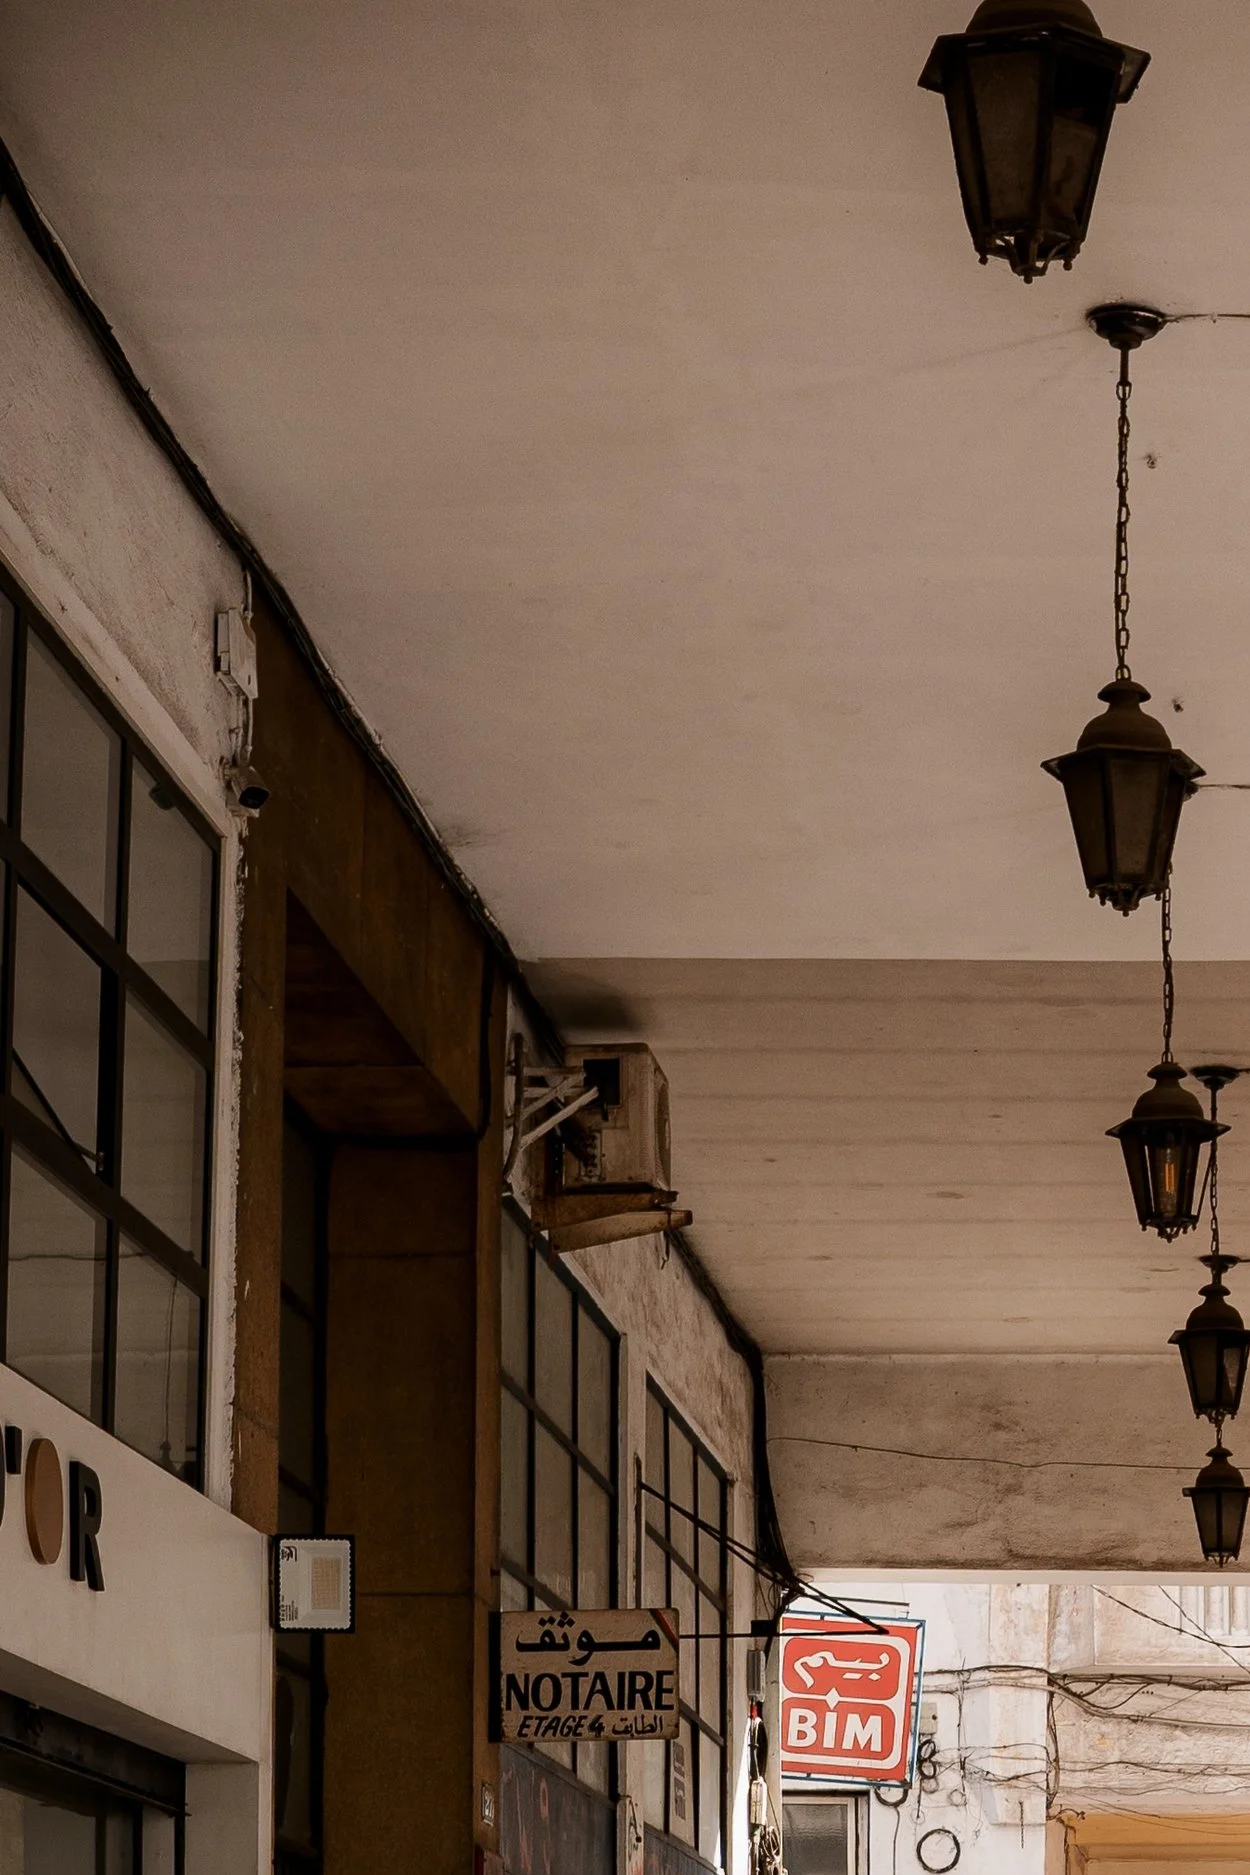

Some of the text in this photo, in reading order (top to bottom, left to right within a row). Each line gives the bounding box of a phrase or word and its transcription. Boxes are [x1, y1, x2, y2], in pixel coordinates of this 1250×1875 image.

[0, 1424, 105, 1591] 'OR
[514, 1611, 661, 1666] موثق
[793, 1650, 891, 1689] بيم
[505, 1670, 675, 1712] NOTAIRE
[517, 1715, 588, 1739] ETAGE
[611, 1715, 664, 1738] الطابق
[786, 1707, 883, 1753] BIM
